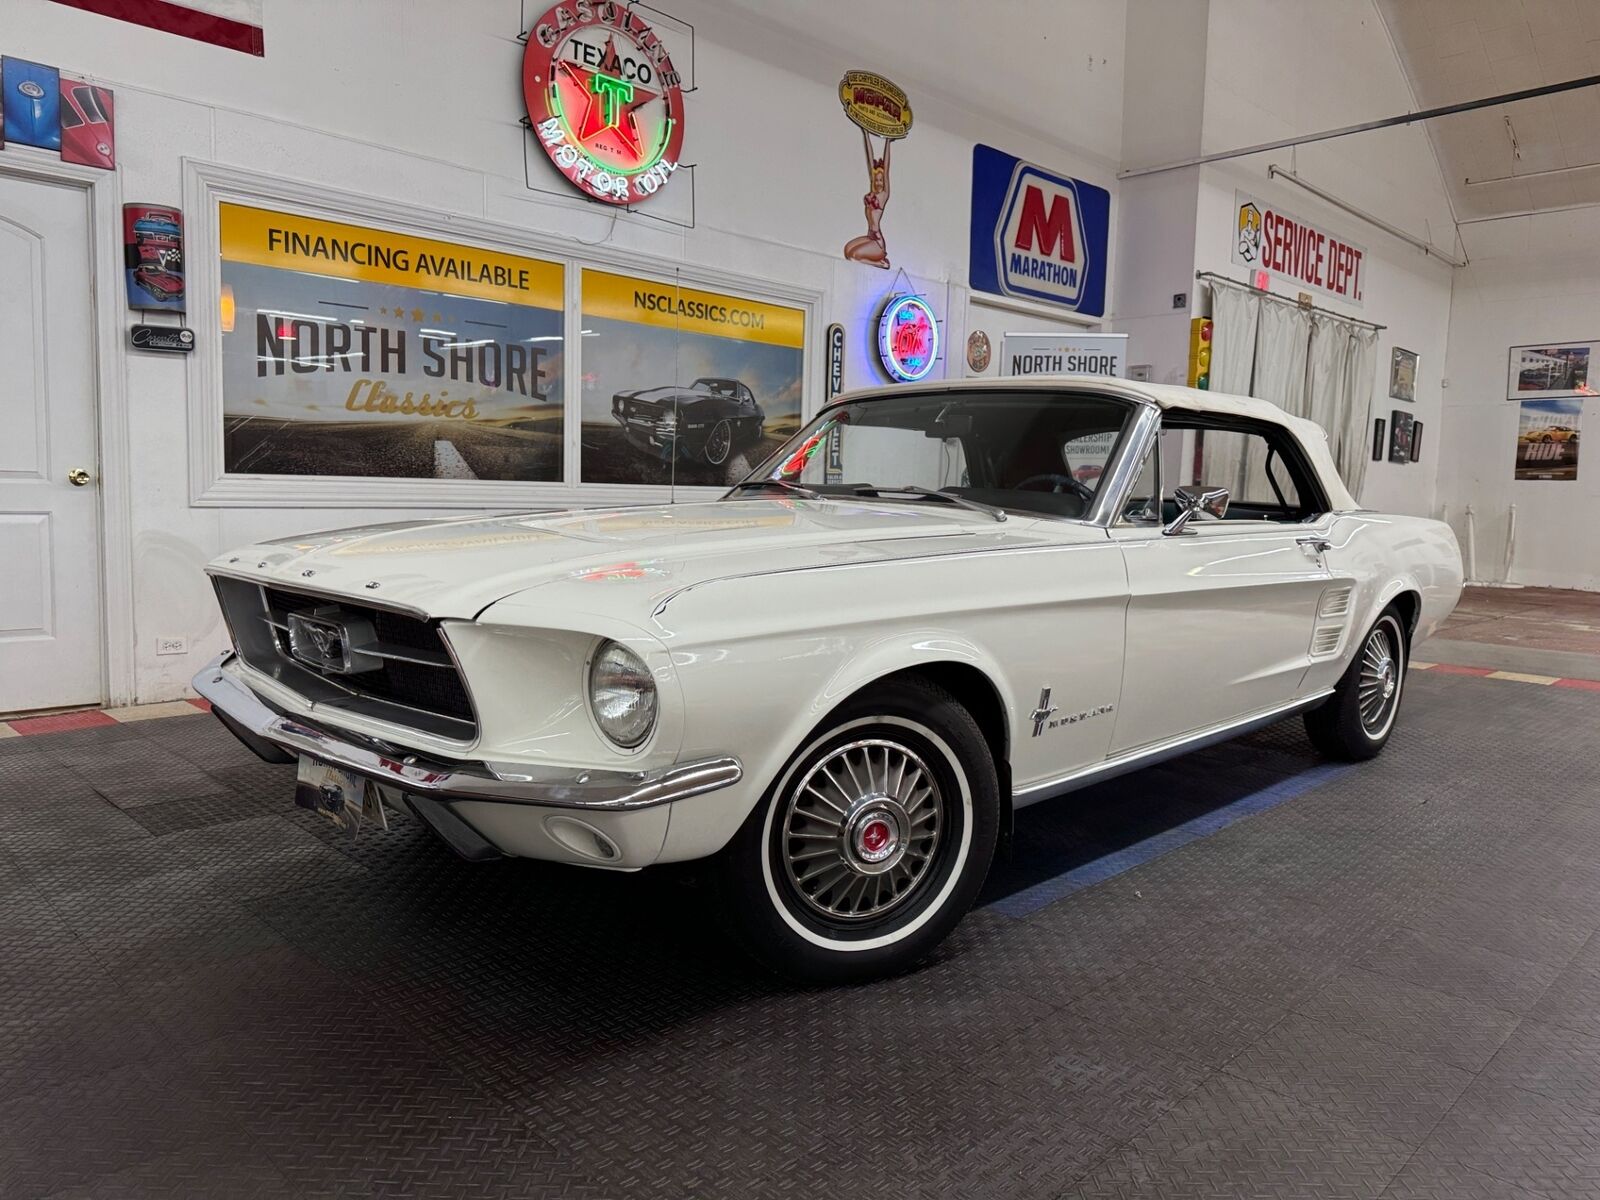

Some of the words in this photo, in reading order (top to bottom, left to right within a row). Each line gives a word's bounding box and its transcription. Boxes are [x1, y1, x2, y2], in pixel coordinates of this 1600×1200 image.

[536, 0, 682, 88] GASOLINE
[570, 39, 651, 84] TEXACO
[853, 87, 902, 122] MOPAR
[537, 118, 629, 200] MOTOR
[633, 159, 678, 195] OIL
[1014, 184, 1075, 263] M
[268, 228, 410, 271] FINANCING
[415, 254, 530, 290] AVAILABLE
[1009, 252, 1078, 288] MARATHON
[1262, 210, 1325, 286] SERVICE
[1326, 239, 1363, 301] DEPT.
[634, 291, 765, 330] NSCLASSICS.COM
[257, 313, 406, 377] NORTH
[422, 336, 548, 402] SHORE
[1012, 353, 1062, 376] NORTH
[1067, 355, 1118, 377] SHORE
[346, 378, 480, 420] Classics
[831, 332, 843, 466] CHEVLET
[1524, 443, 1565, 460] RIDE
